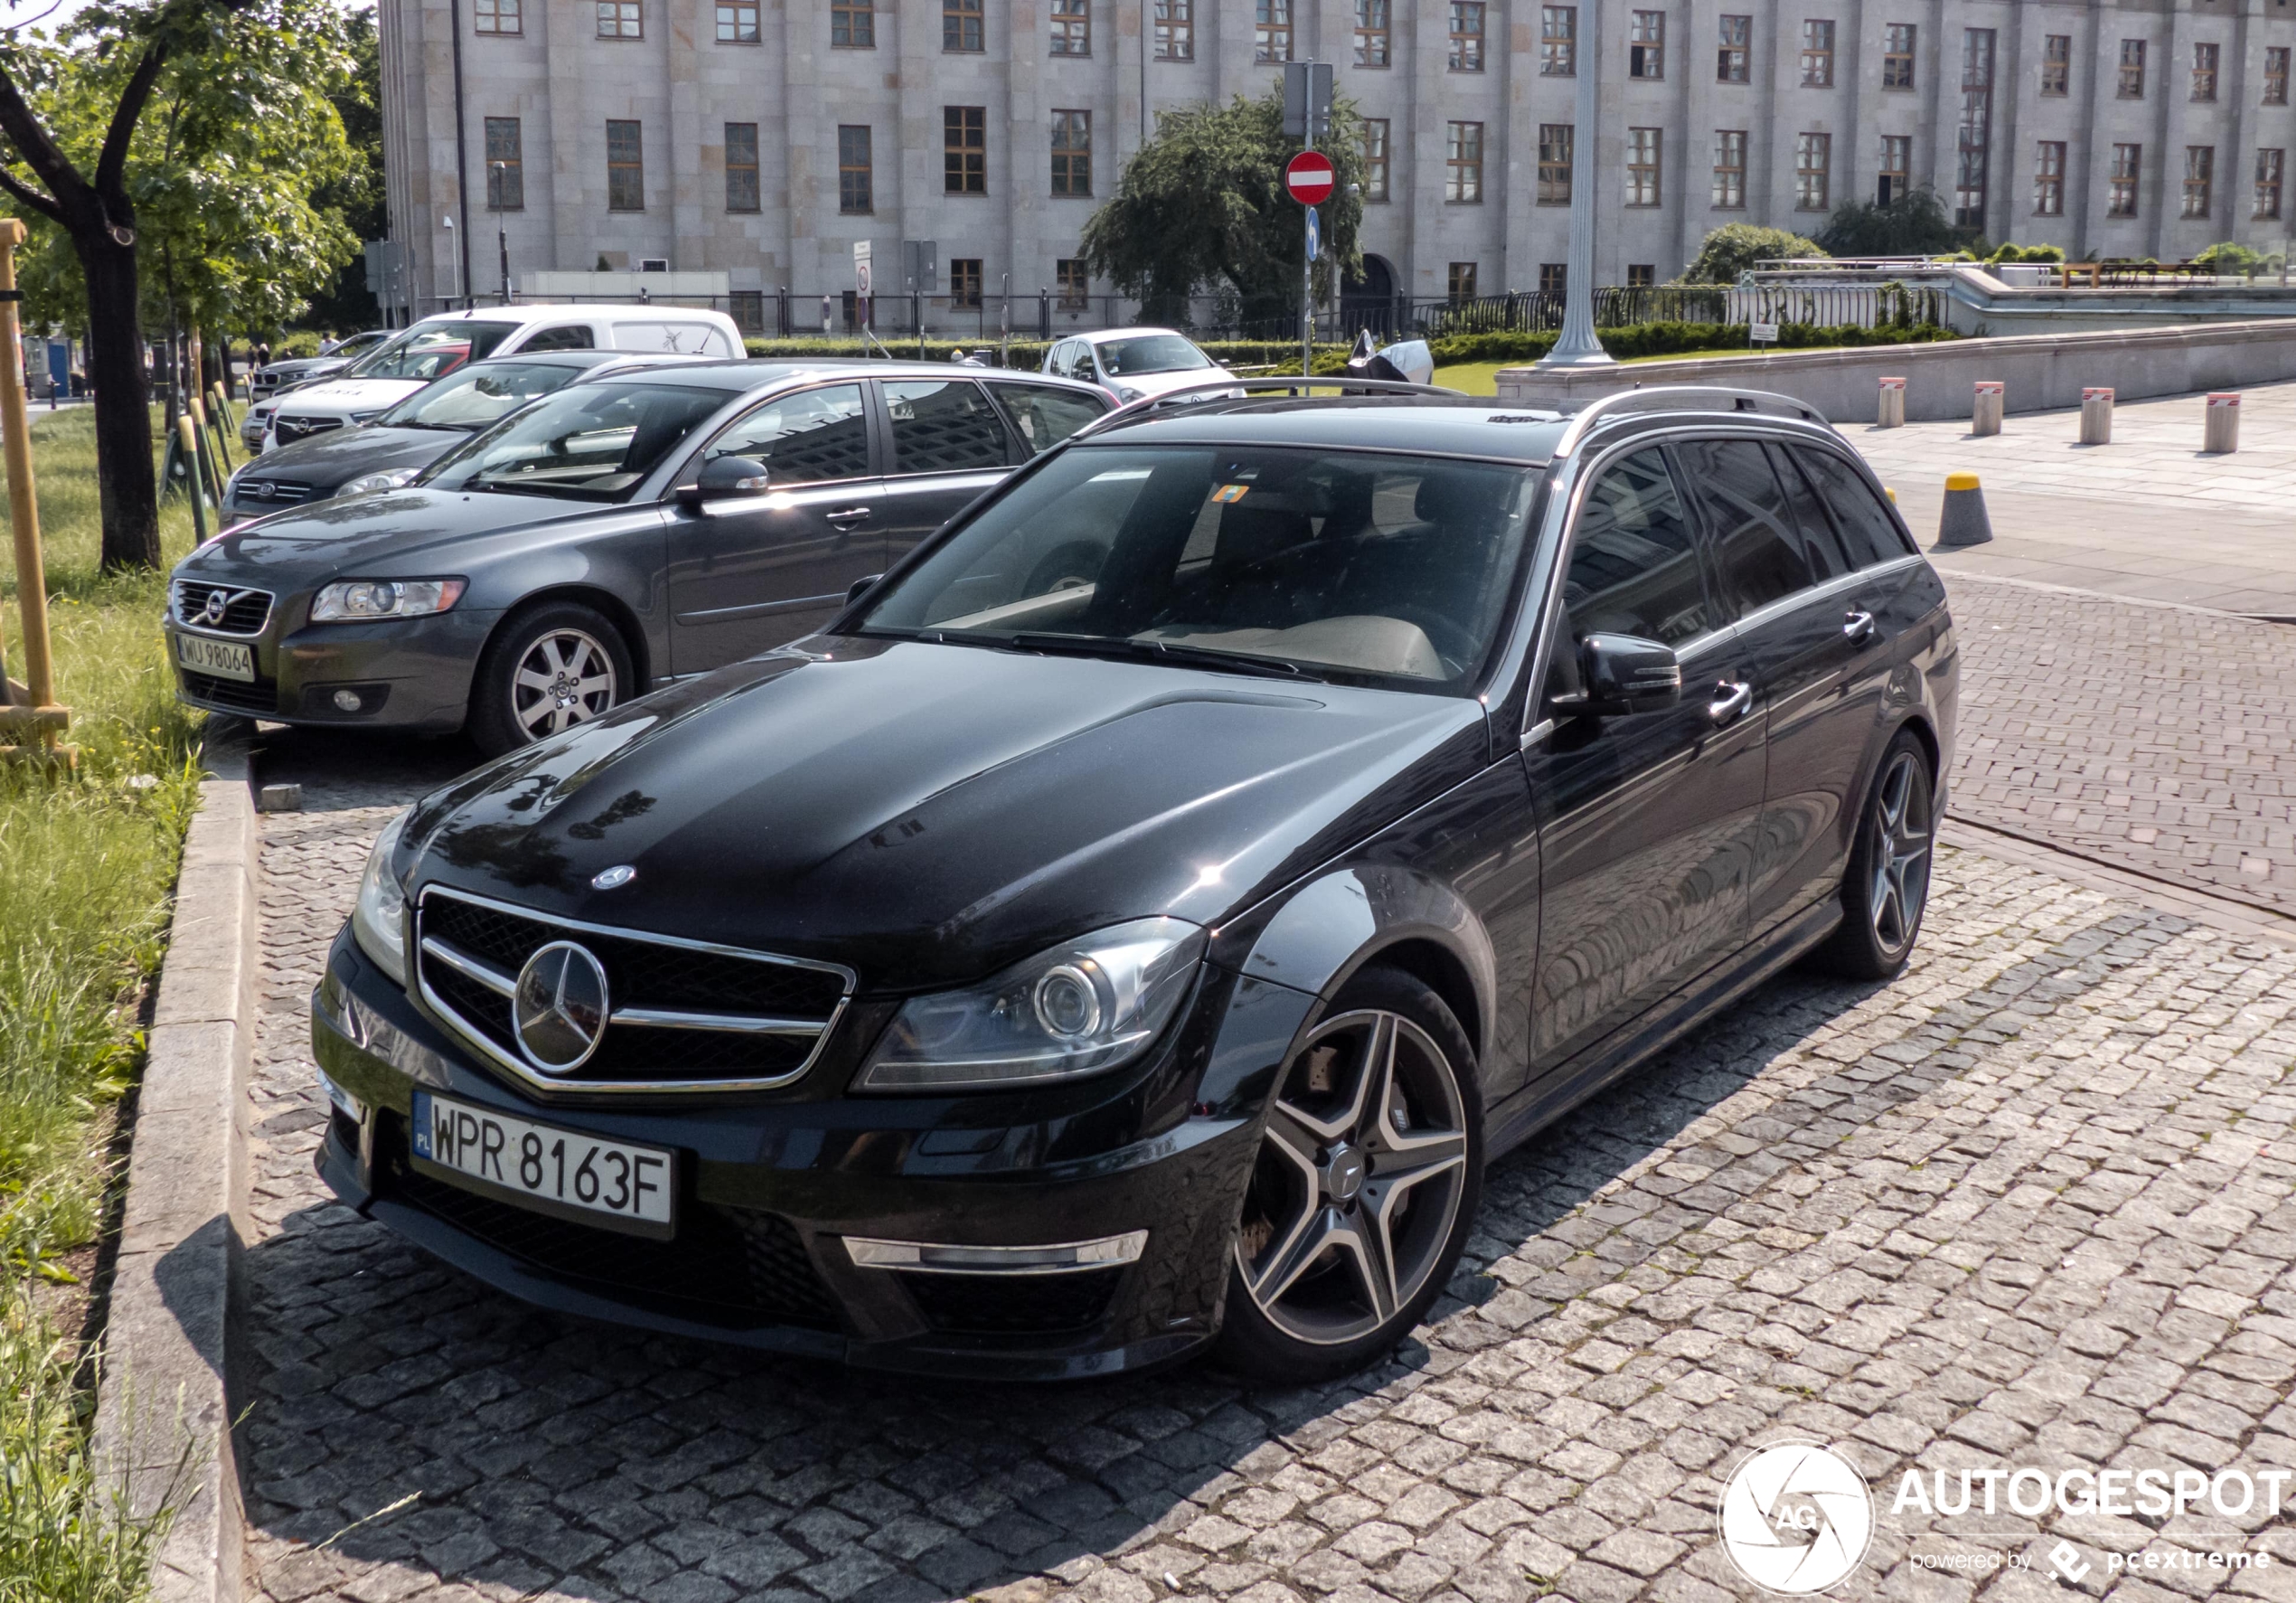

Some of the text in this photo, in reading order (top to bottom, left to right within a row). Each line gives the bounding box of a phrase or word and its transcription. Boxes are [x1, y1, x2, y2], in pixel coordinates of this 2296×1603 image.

[183, 637, 250, 673] WU 98064
[417, 1132, 430, 1151] PL
[434, 1104, 663, 1213] WPR 8163F
